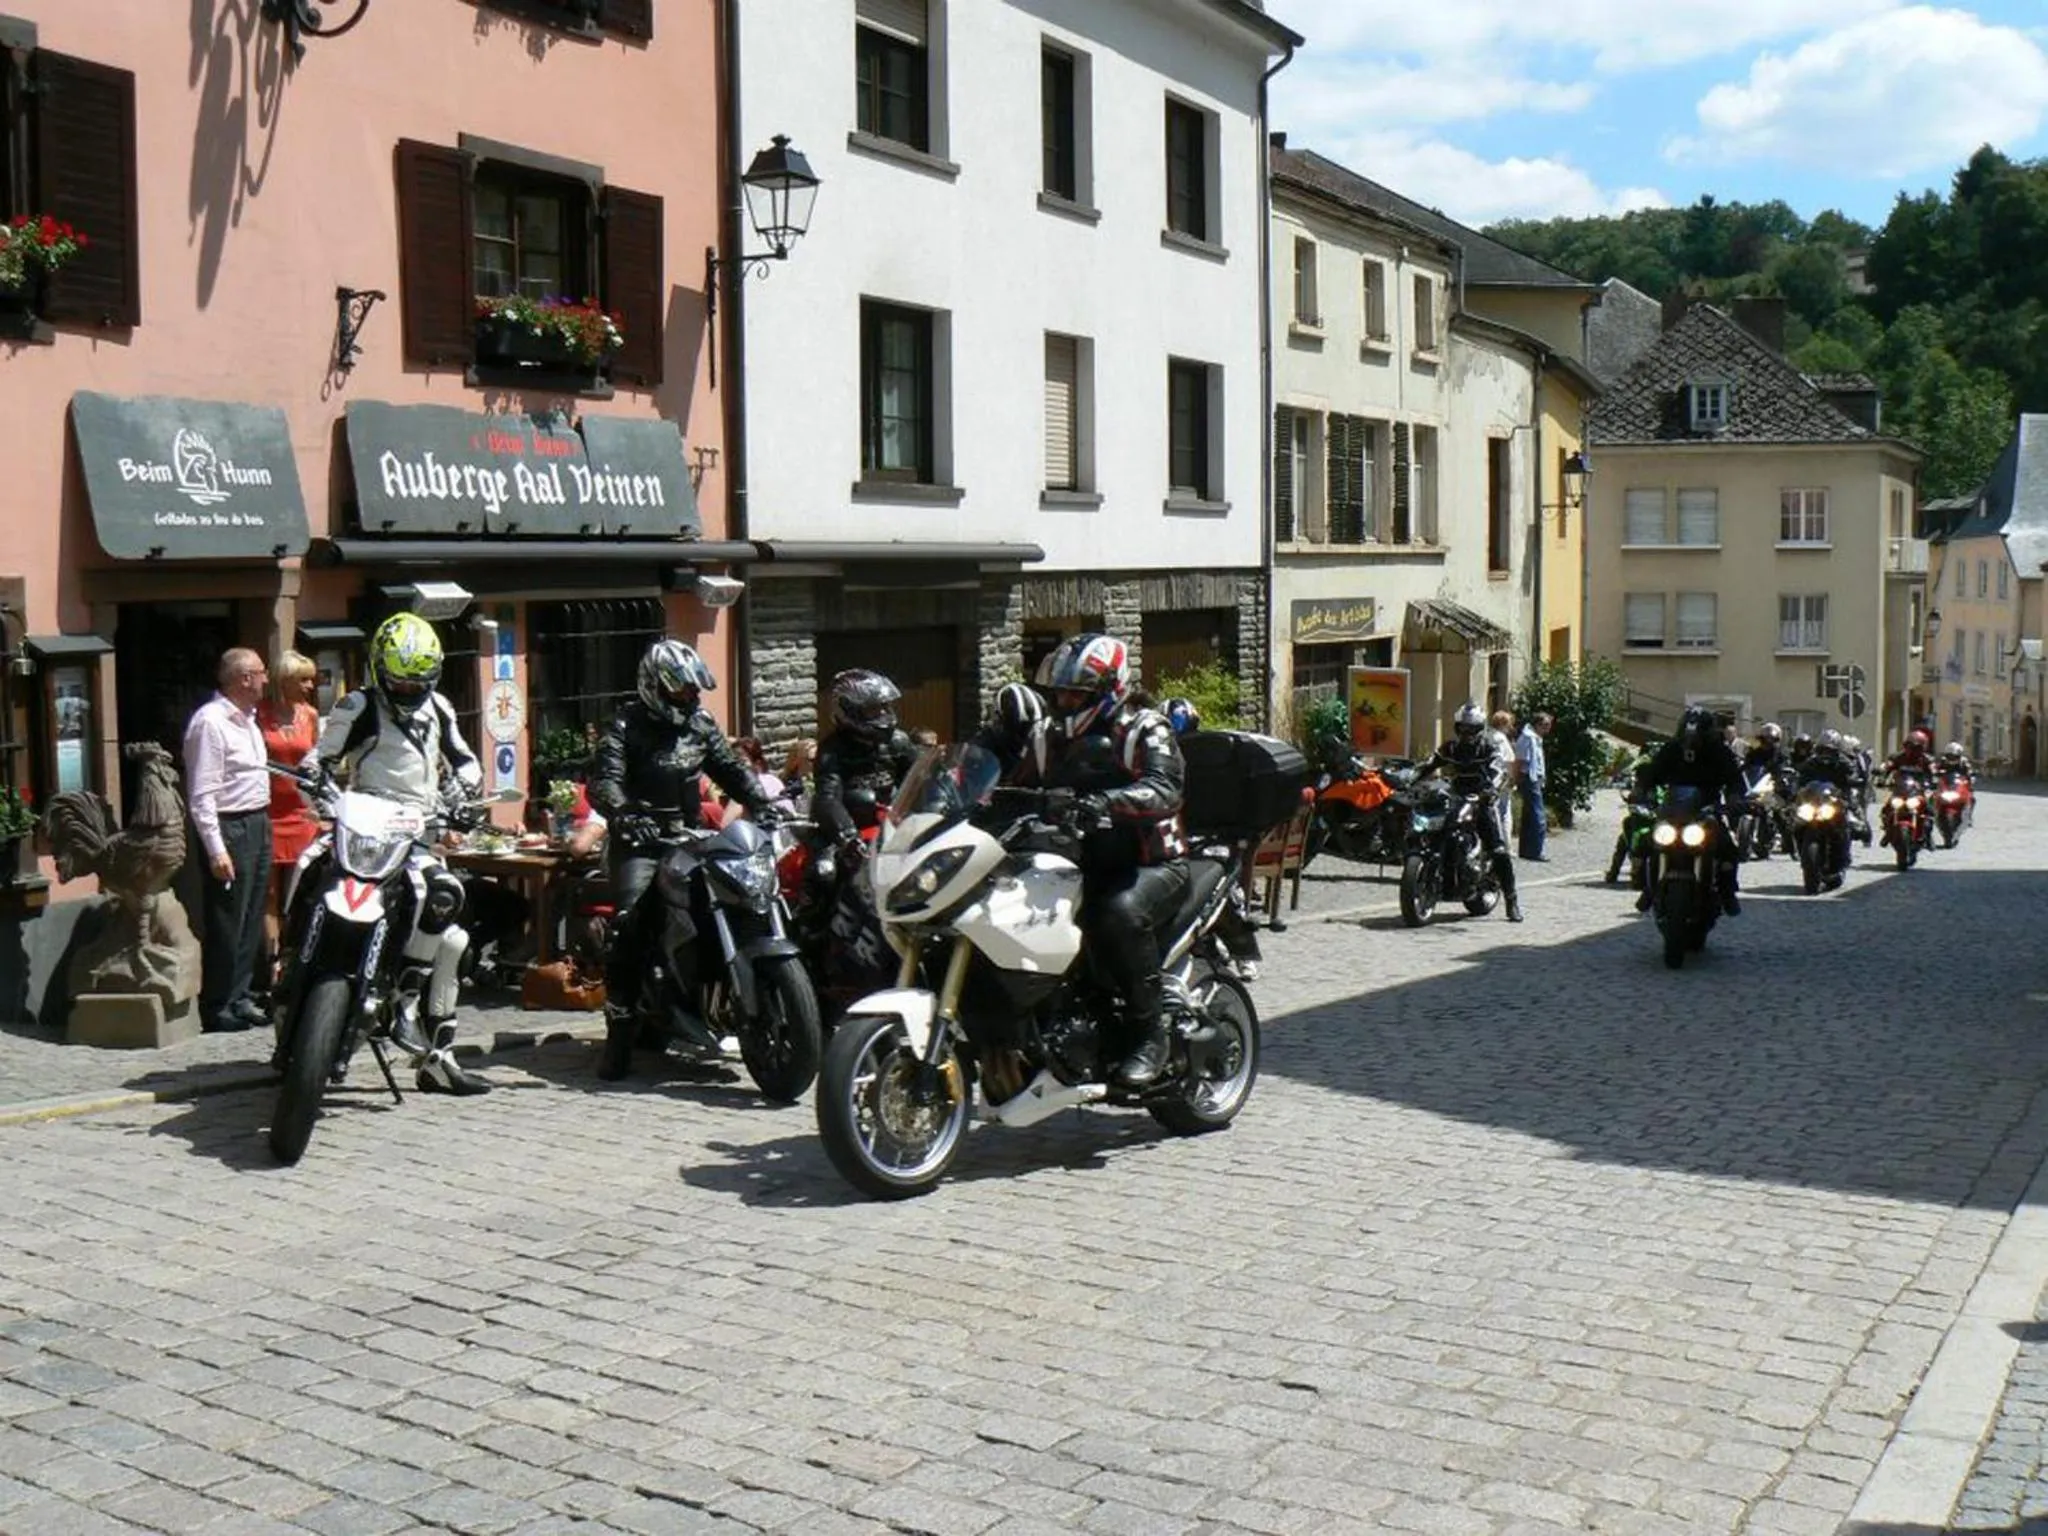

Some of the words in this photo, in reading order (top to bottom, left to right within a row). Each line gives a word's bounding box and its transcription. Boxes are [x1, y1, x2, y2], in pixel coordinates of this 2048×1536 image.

[117, 457, 174, 483] Beim
[220, 459, 272, 486] Hunn
[379, 450, 510, 514] Auberge
[513, 462, 567, 506] Aal
[568, 463, 665, 507] Veinen
